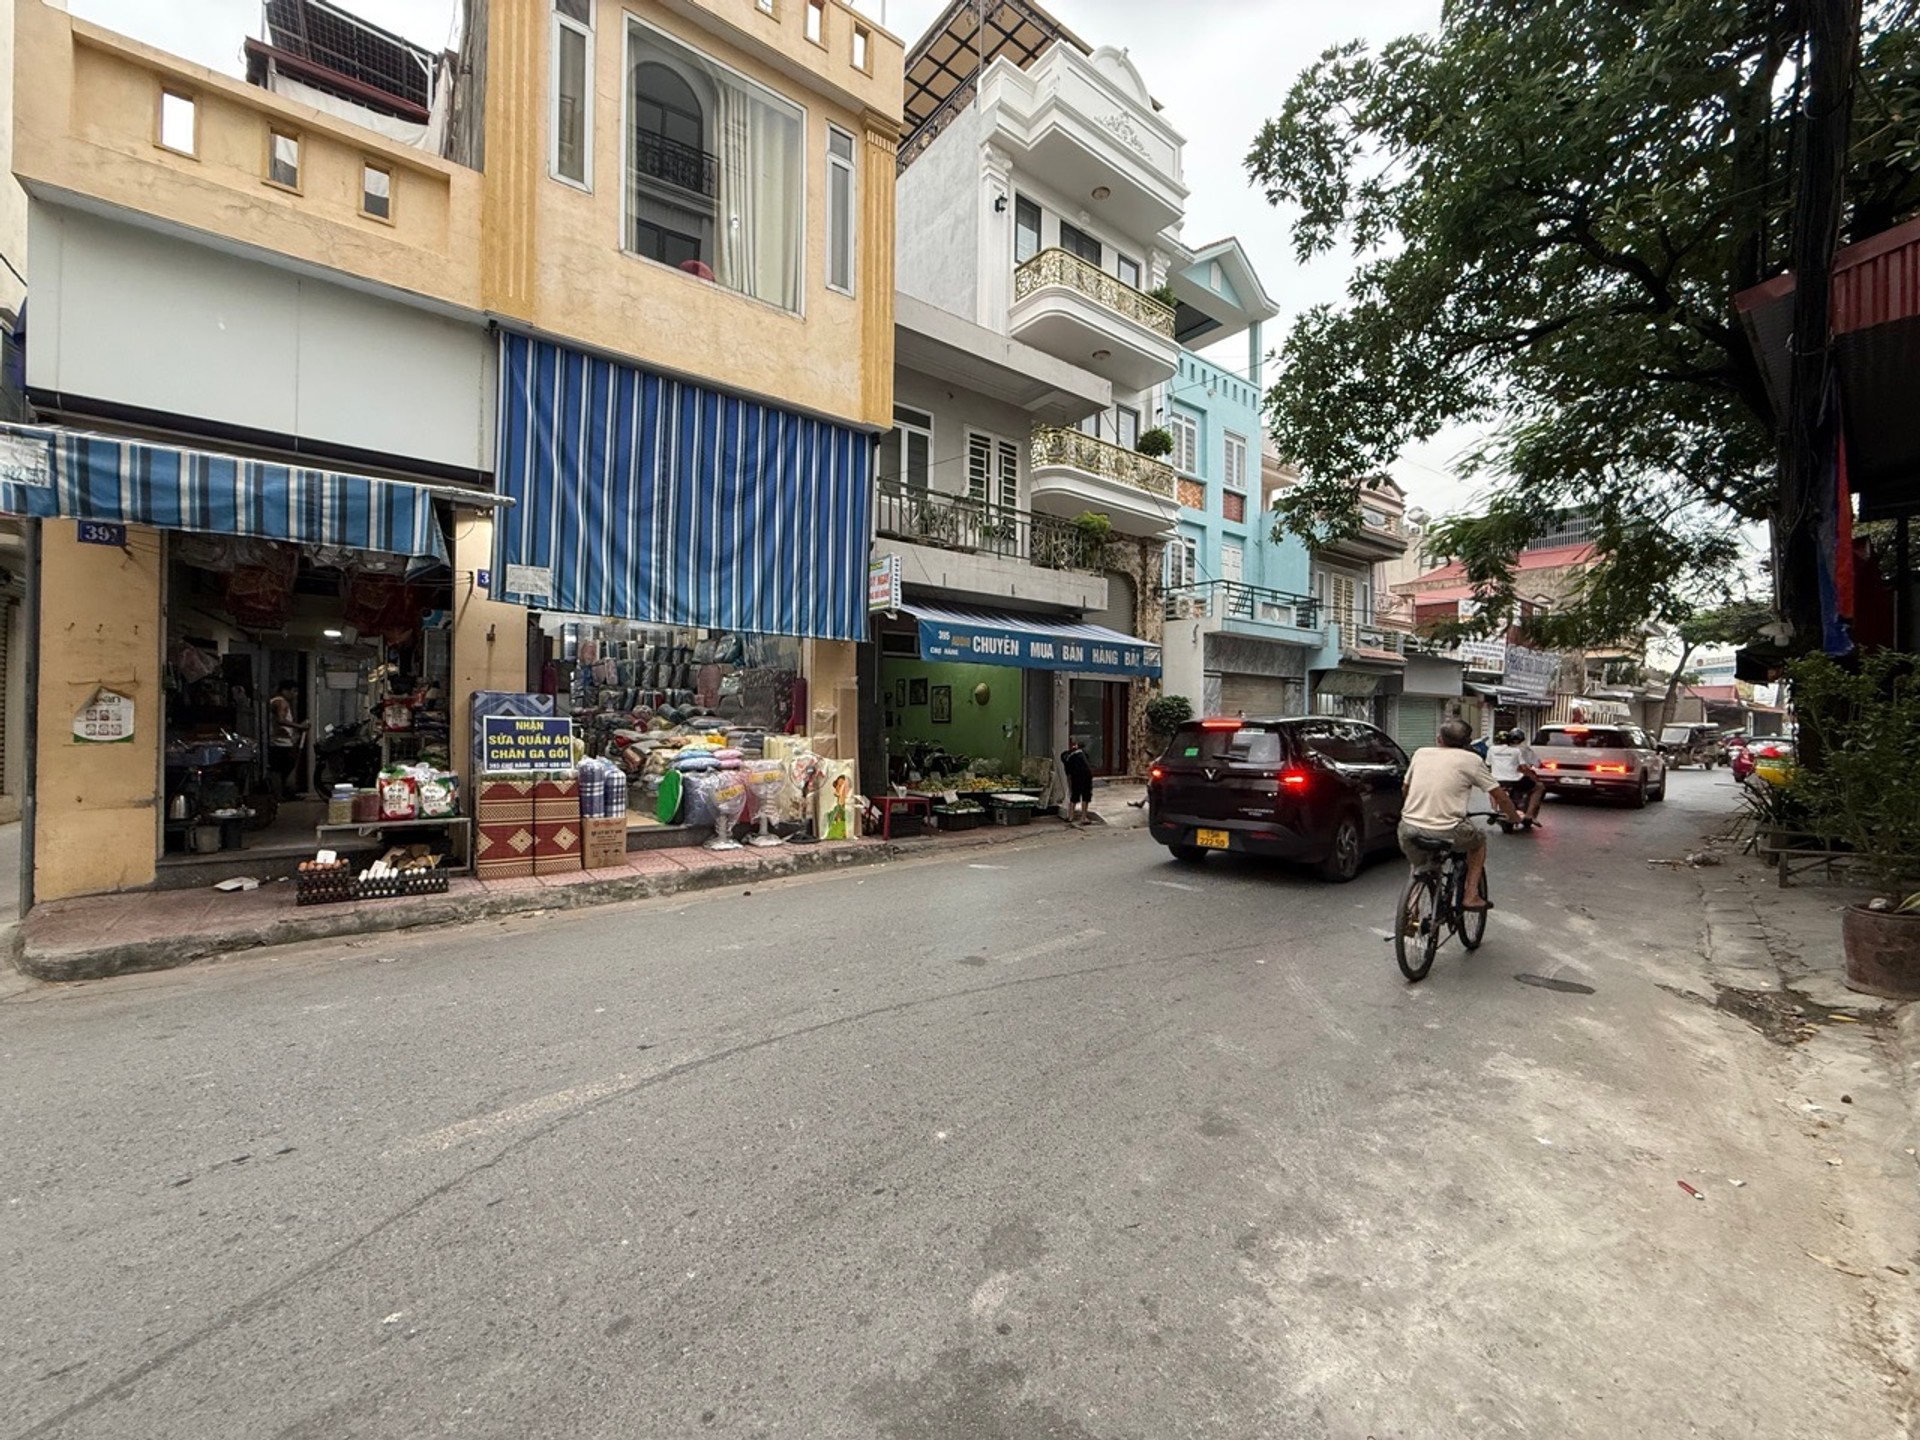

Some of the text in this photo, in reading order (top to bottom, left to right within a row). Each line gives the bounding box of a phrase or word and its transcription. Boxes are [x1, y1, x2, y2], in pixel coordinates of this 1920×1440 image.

[973, 635, 1019, 656] CHUYÊN
[1030, 641, 1054, 660] MUA
[1062, 642, 1083, 662] BÁN
[1092, 645, 1118, 665] HÀNG
[515, 720, 544, 732] NHẬN
[488, 732, 514, 745] SỬA
[529, 749, 546, 759] GA
[548, 746, 568, 759] GỐI
